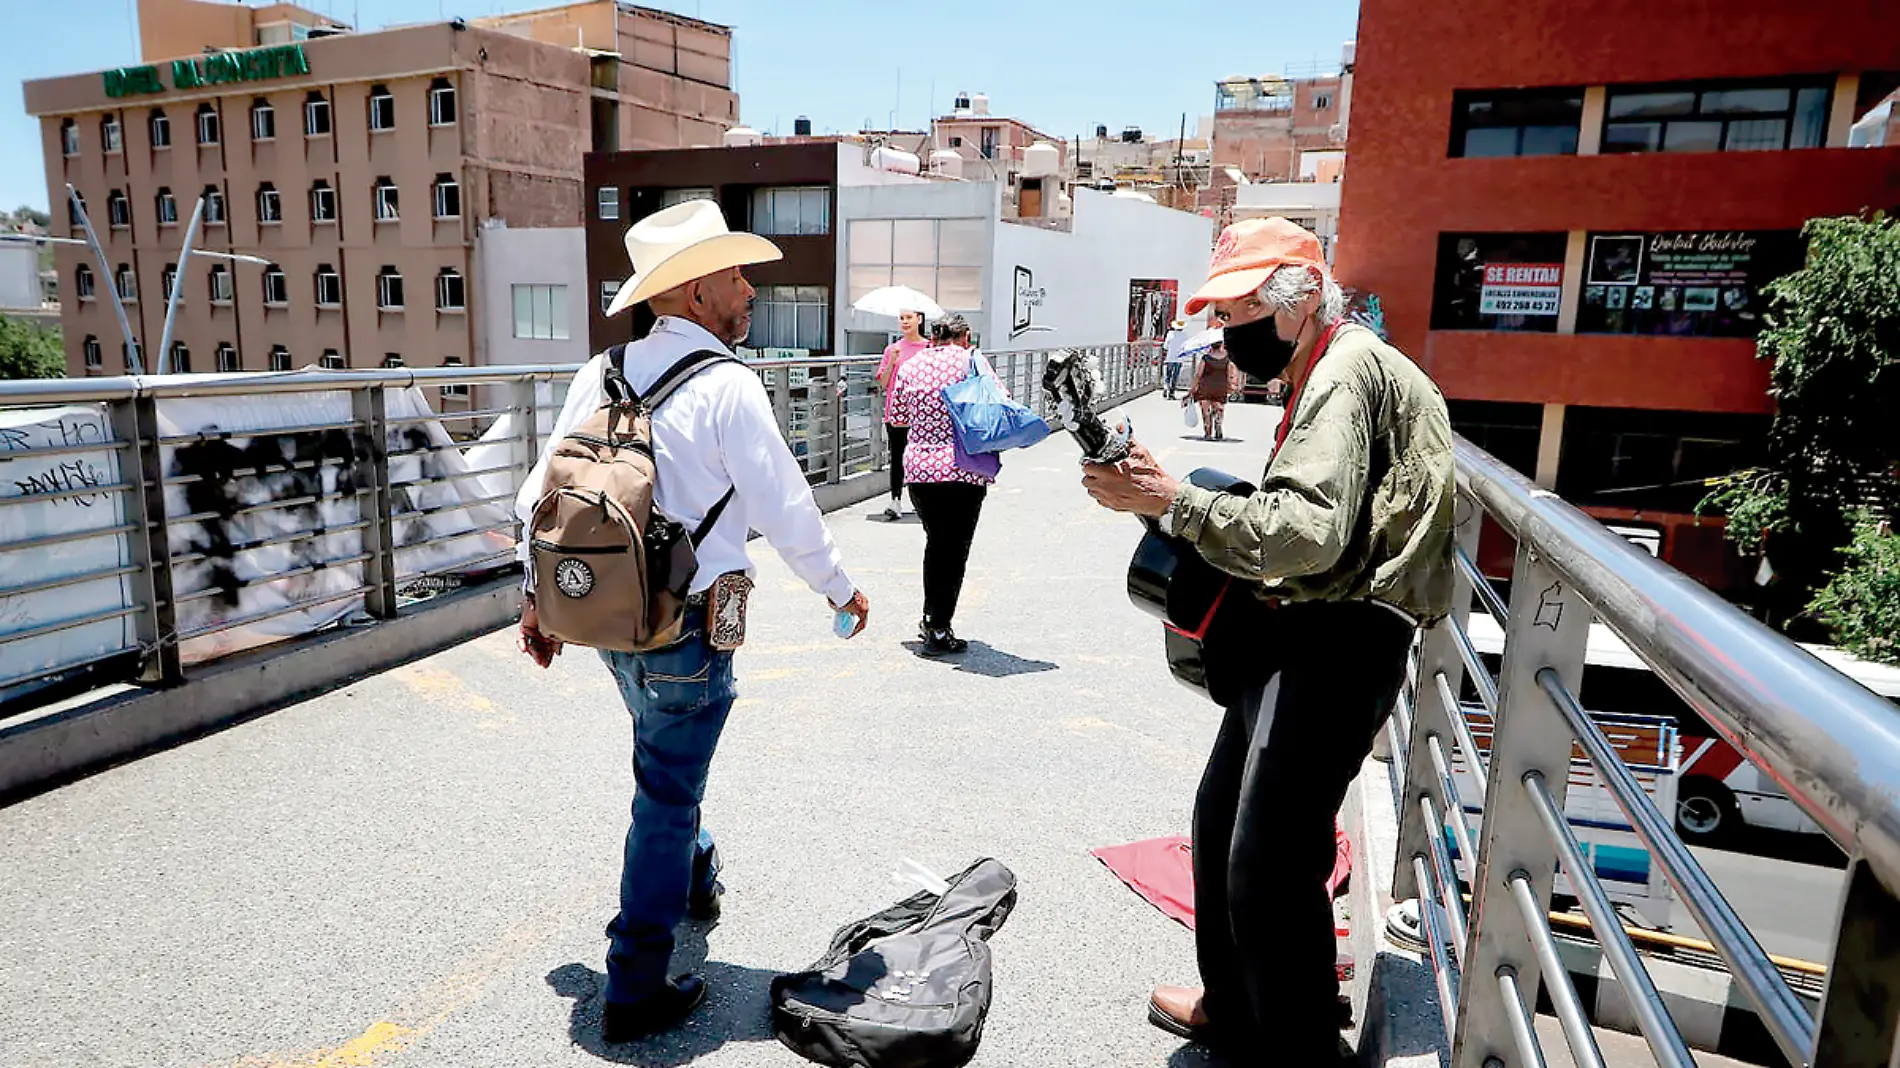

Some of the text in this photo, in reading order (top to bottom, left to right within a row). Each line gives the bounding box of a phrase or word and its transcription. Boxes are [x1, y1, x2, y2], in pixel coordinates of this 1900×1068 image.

[103, 65, 164, 97] HOTEL
[1487, 266, 1560, 283] SE RENTAN
